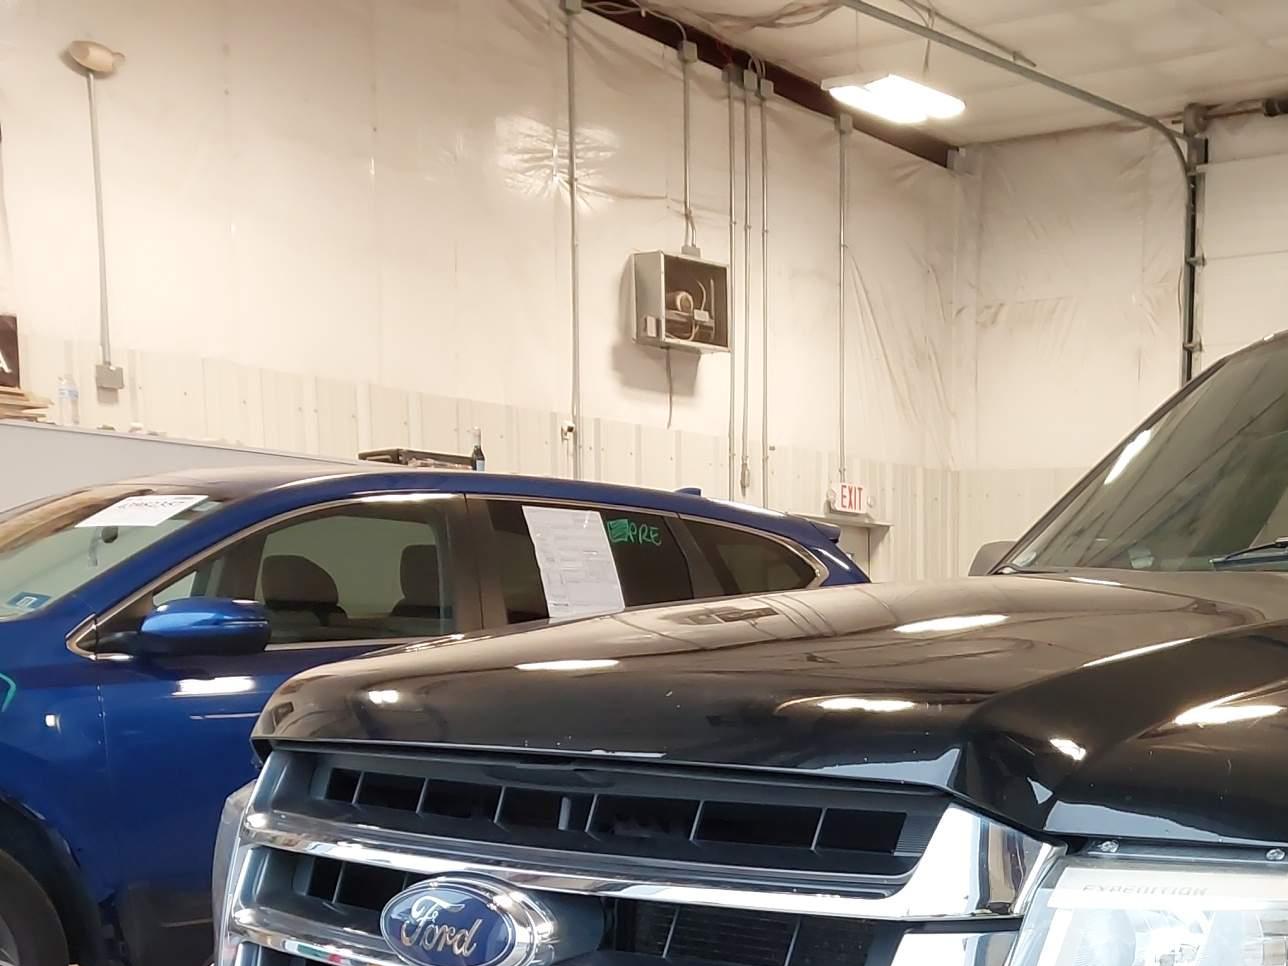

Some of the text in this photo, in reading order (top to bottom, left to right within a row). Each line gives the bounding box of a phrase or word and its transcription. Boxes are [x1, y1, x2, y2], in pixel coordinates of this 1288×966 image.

[841, 484, 863, 511] EXIT
[1082, 884, 1208, 896] EXPEDITION
[401, 895, 483, 958] Ford
